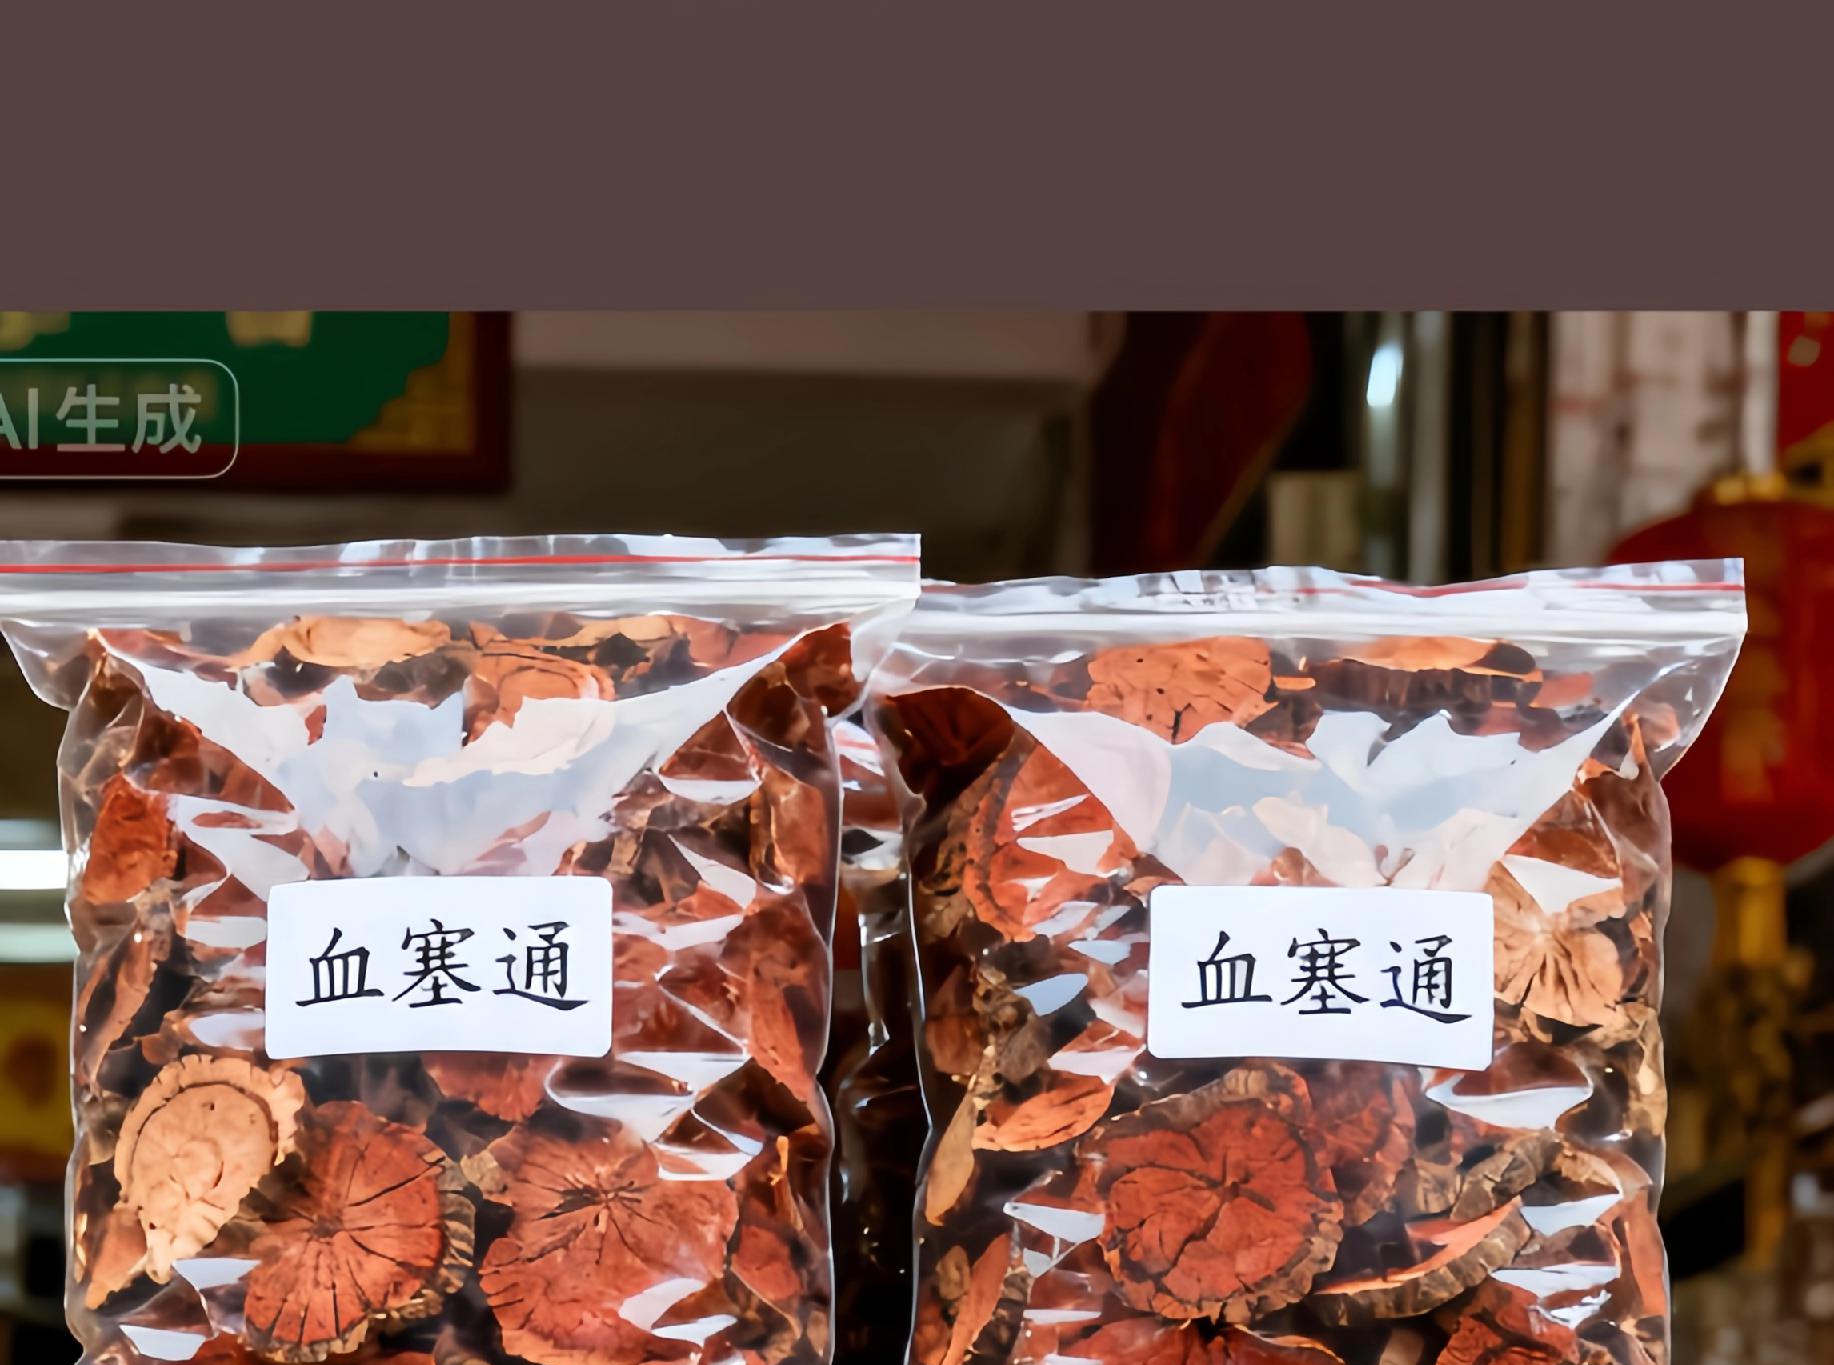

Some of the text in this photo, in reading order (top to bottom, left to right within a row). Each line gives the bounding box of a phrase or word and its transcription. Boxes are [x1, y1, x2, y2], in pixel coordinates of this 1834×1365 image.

[296, 919, 588, 1011] 血塞通
[1182, 929, 1472, 1024] 血塞通
